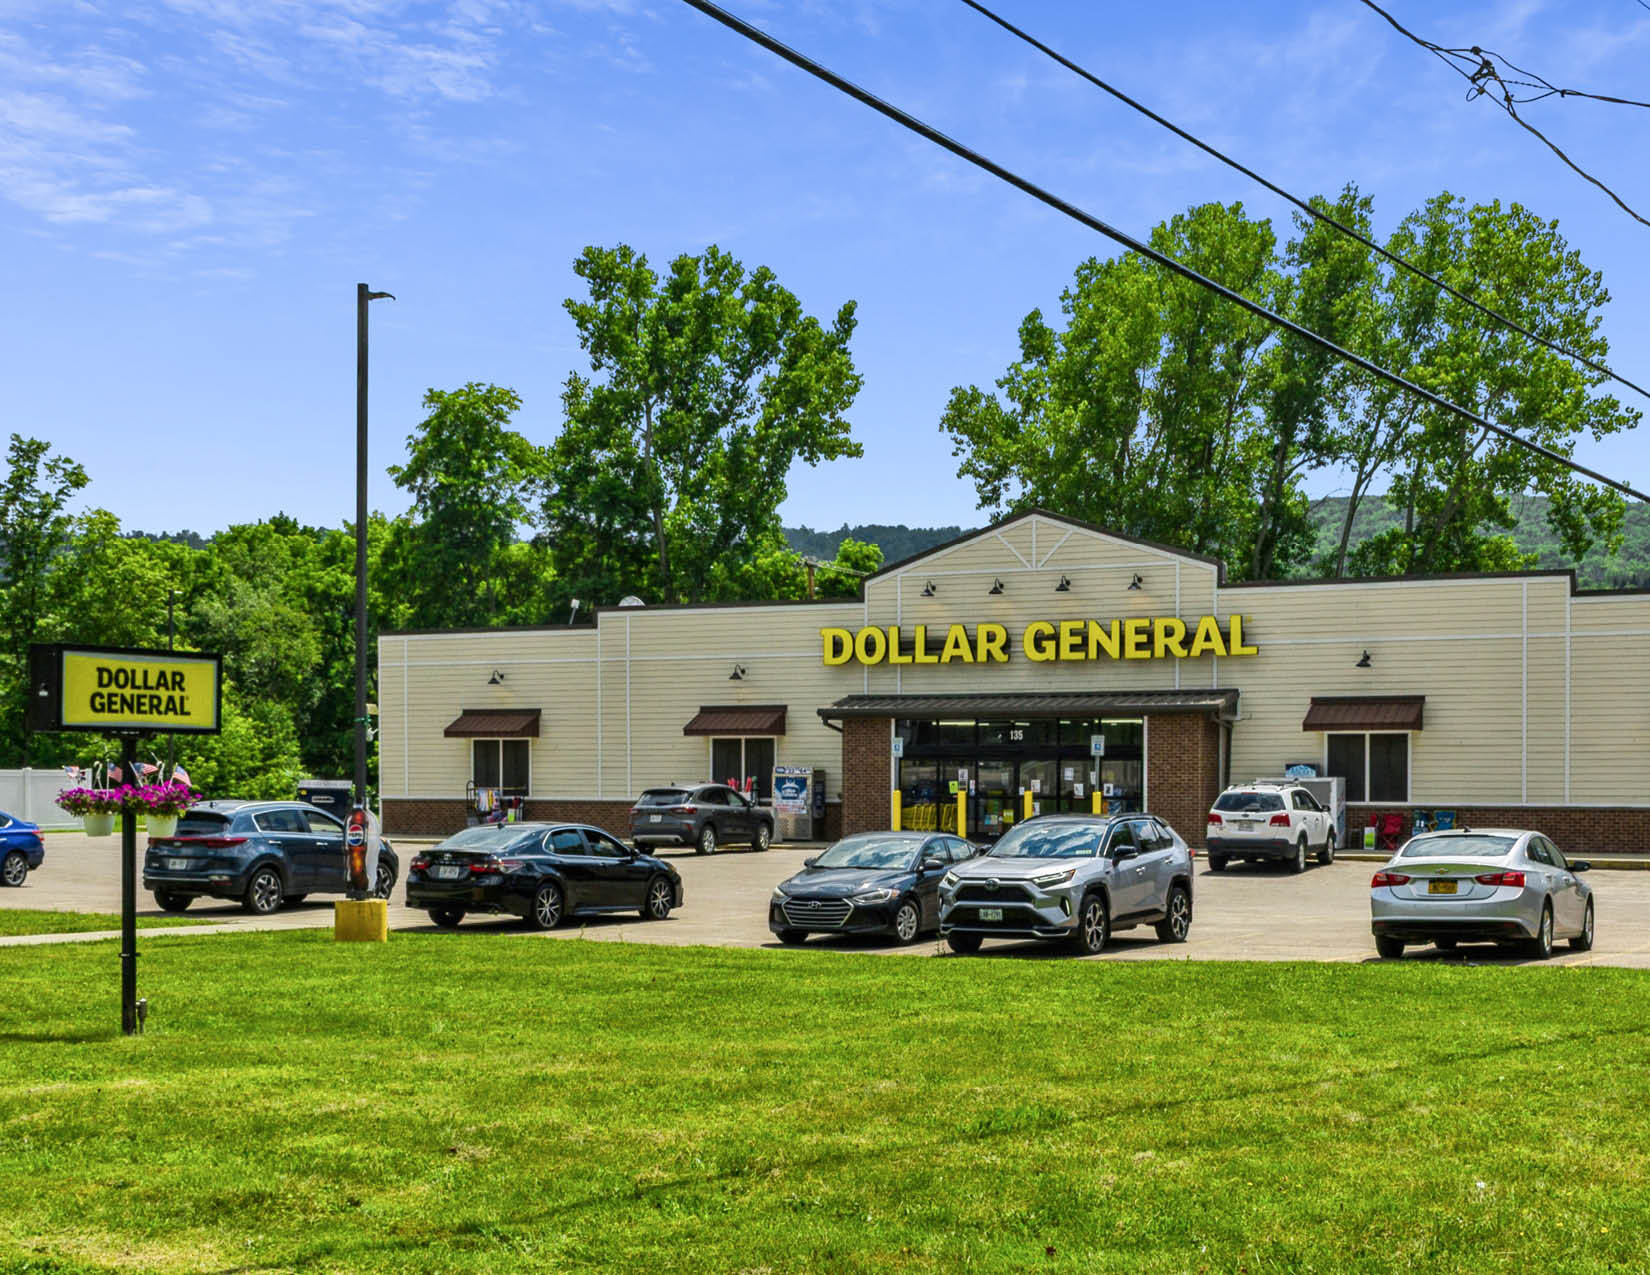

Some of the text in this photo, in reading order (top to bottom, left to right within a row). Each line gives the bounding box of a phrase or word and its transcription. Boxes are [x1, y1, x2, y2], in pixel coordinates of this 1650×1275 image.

[820, 615, 1259, 666] DOLLAR GENERAL
[96, 666, 185, 692] DOLLAR
[89, 691, 192, 716] GENERAL
[1010, 729, 1024, 741] 135
